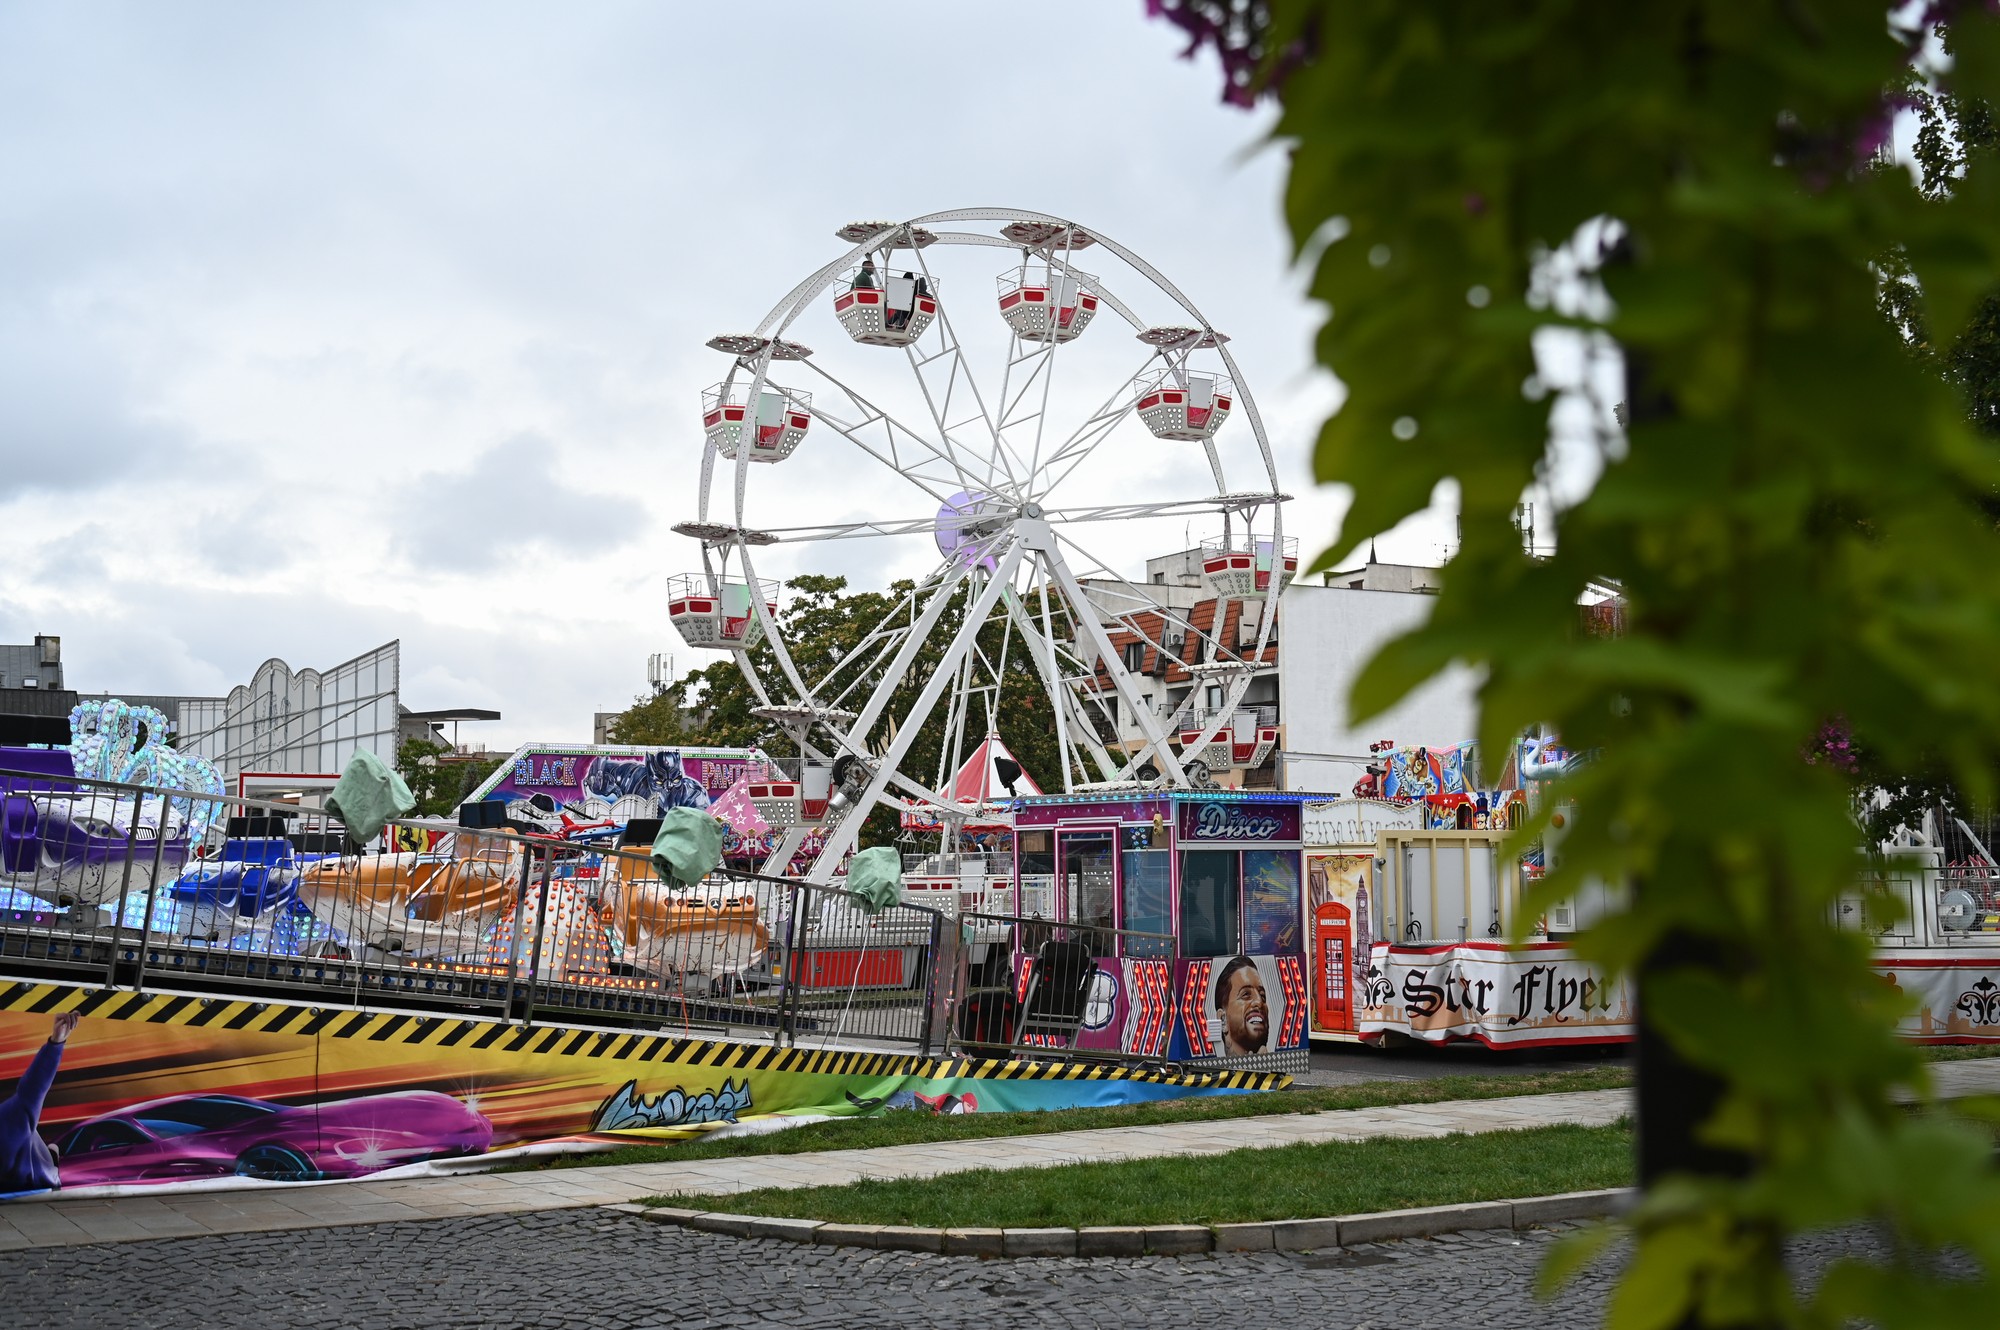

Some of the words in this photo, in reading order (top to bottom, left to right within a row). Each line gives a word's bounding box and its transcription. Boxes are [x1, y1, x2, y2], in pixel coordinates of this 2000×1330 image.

[515, 757, 577, 785] BLACK
[702, 760, 749, 790] PANT
[1196, 802, 1281, 838] Disco
[1402, 964, 1494, 1018] Star
[1507, 964, 1614, 1027] Flyer
